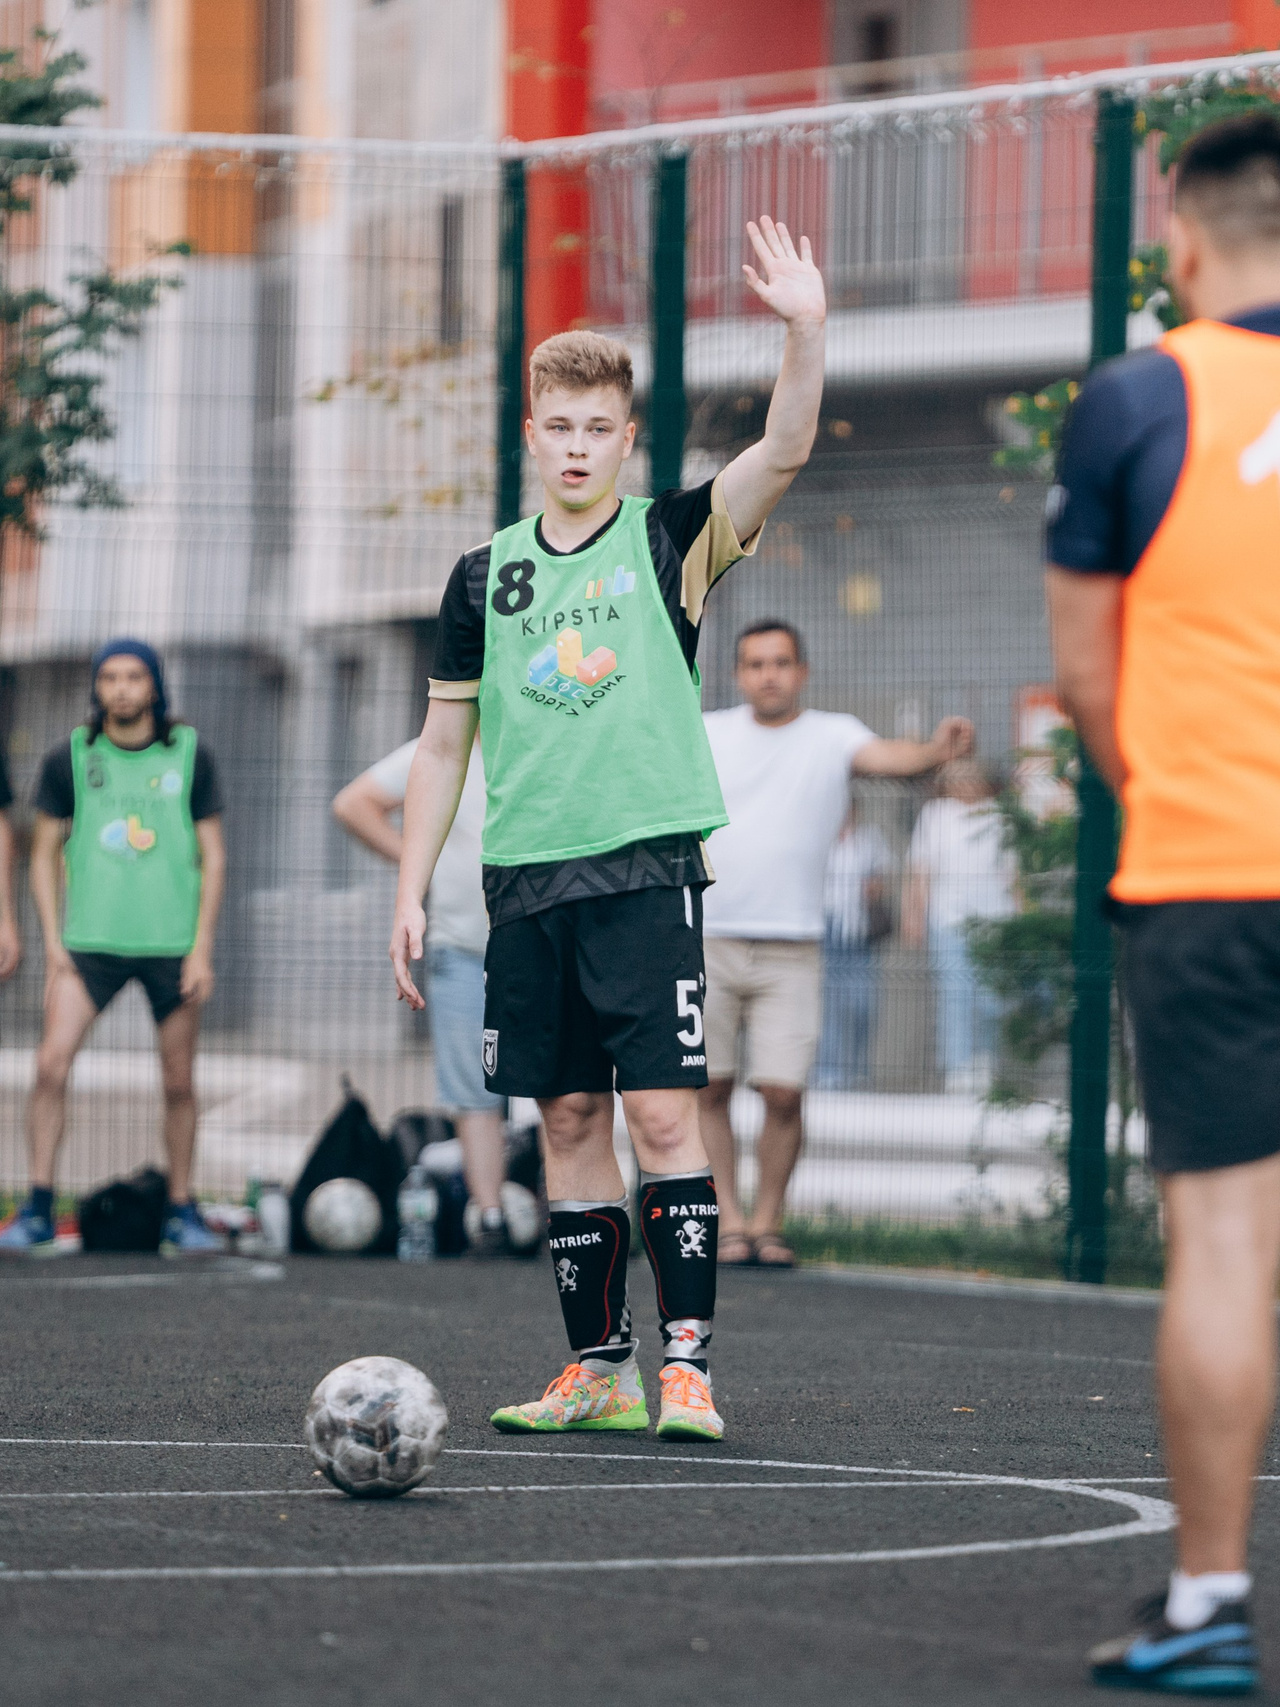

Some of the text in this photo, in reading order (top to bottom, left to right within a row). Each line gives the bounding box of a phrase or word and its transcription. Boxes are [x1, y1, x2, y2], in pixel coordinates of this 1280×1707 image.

[492, 558, 536, 616] 8
[522, 604, 620, 636] KIPSTA
[520, 674, 626, 716] СПОРТ У ДОМА
[676, 980, 703, 1047] 5
[669, 1204, 719, 1217] PATRIC
[549, 1232, 602, 1249] PATRICK
